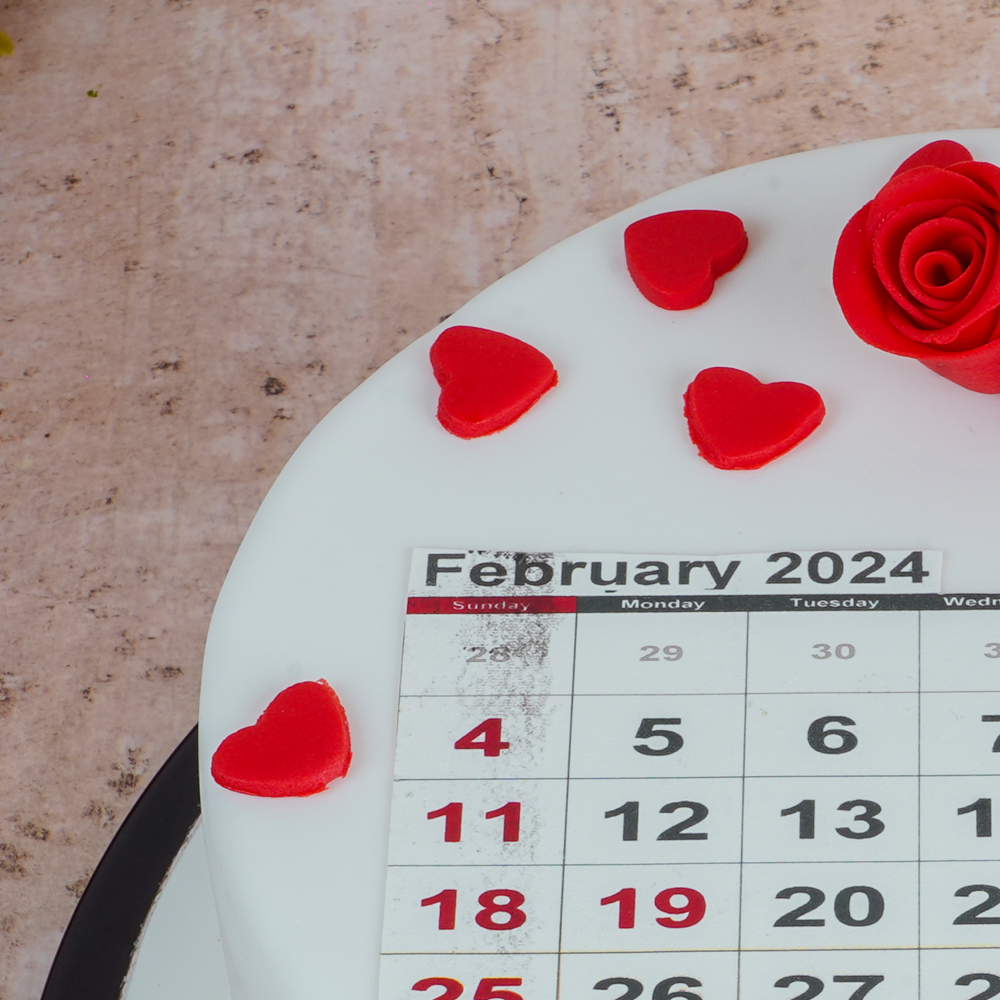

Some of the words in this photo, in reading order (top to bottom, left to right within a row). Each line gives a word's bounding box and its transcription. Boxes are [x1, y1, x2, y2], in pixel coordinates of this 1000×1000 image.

[426, 552, 741, 590] February
[766, 550, 930, 585] 2024
[452, 599, 532, 612] Sunday
[620, 598, 706, 612] Monday
[789, 596, 880, 610] Tuesday
[639, 645, 684, 662] 29
[811, 643, 856, 660] 30
[454, 717, 510, 757] 4
[633, 718, 684, 757] 5
[807, 716, 858, 754] 6
[426, 802, 522, 842] 11
[604, 801, 709, 841] 12
[780, 799, 885, 839] 13
[420, 889, 527, 930] 18
[600, 887, 706, 929] 19
[773, 886, 885, 927] 20
